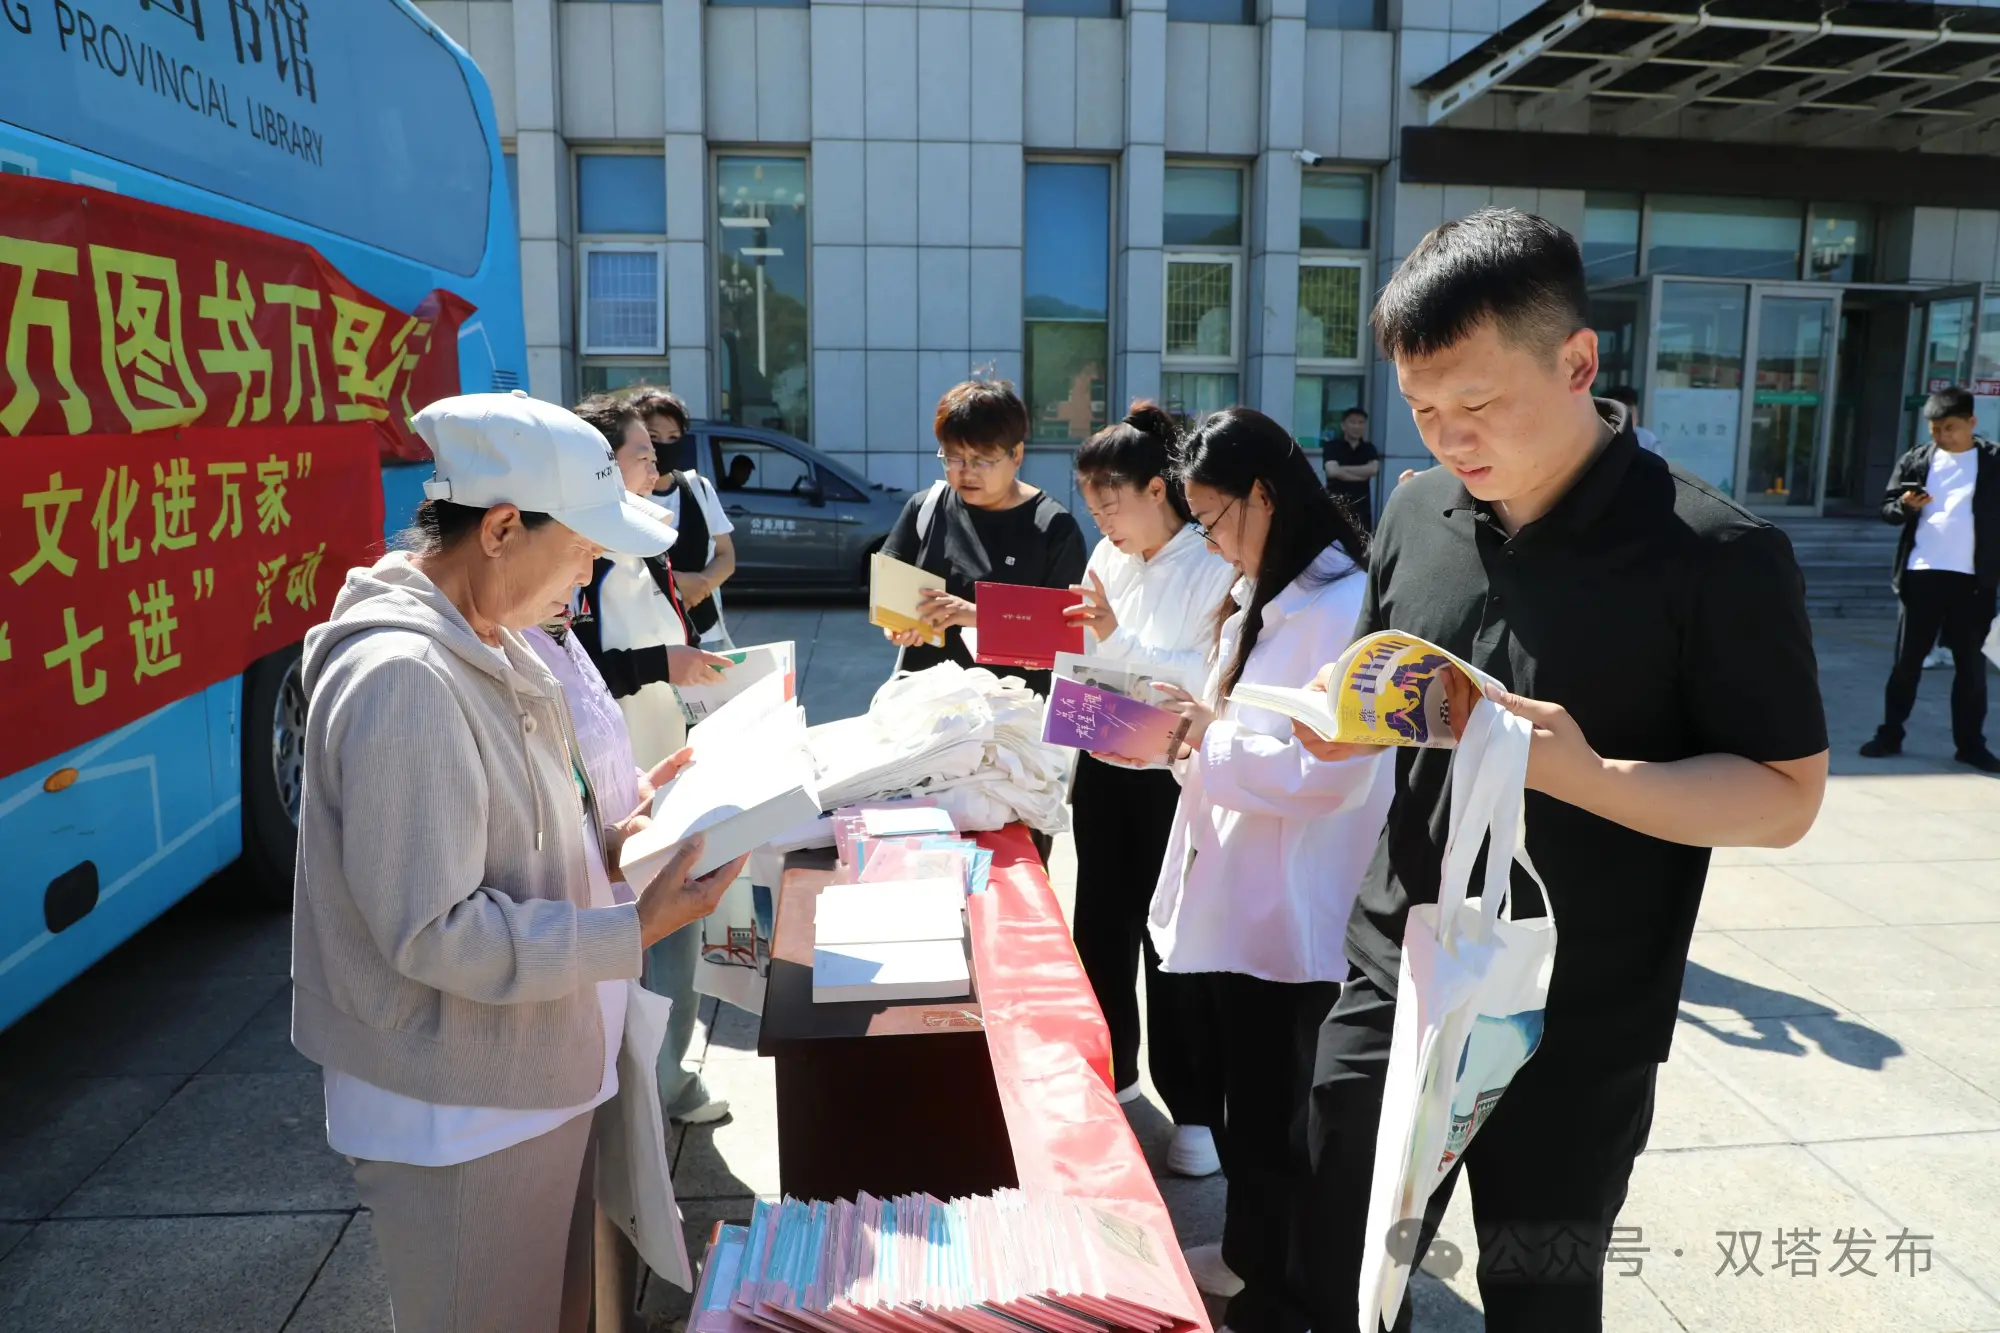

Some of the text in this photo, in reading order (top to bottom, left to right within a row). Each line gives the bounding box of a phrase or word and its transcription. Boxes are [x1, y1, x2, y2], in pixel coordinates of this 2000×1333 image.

[54, 0, 237, 129] PROVINCIAL
[246, 96, 323, 168] LIBRARY
[750, 518, 797, 530] 公务用车
